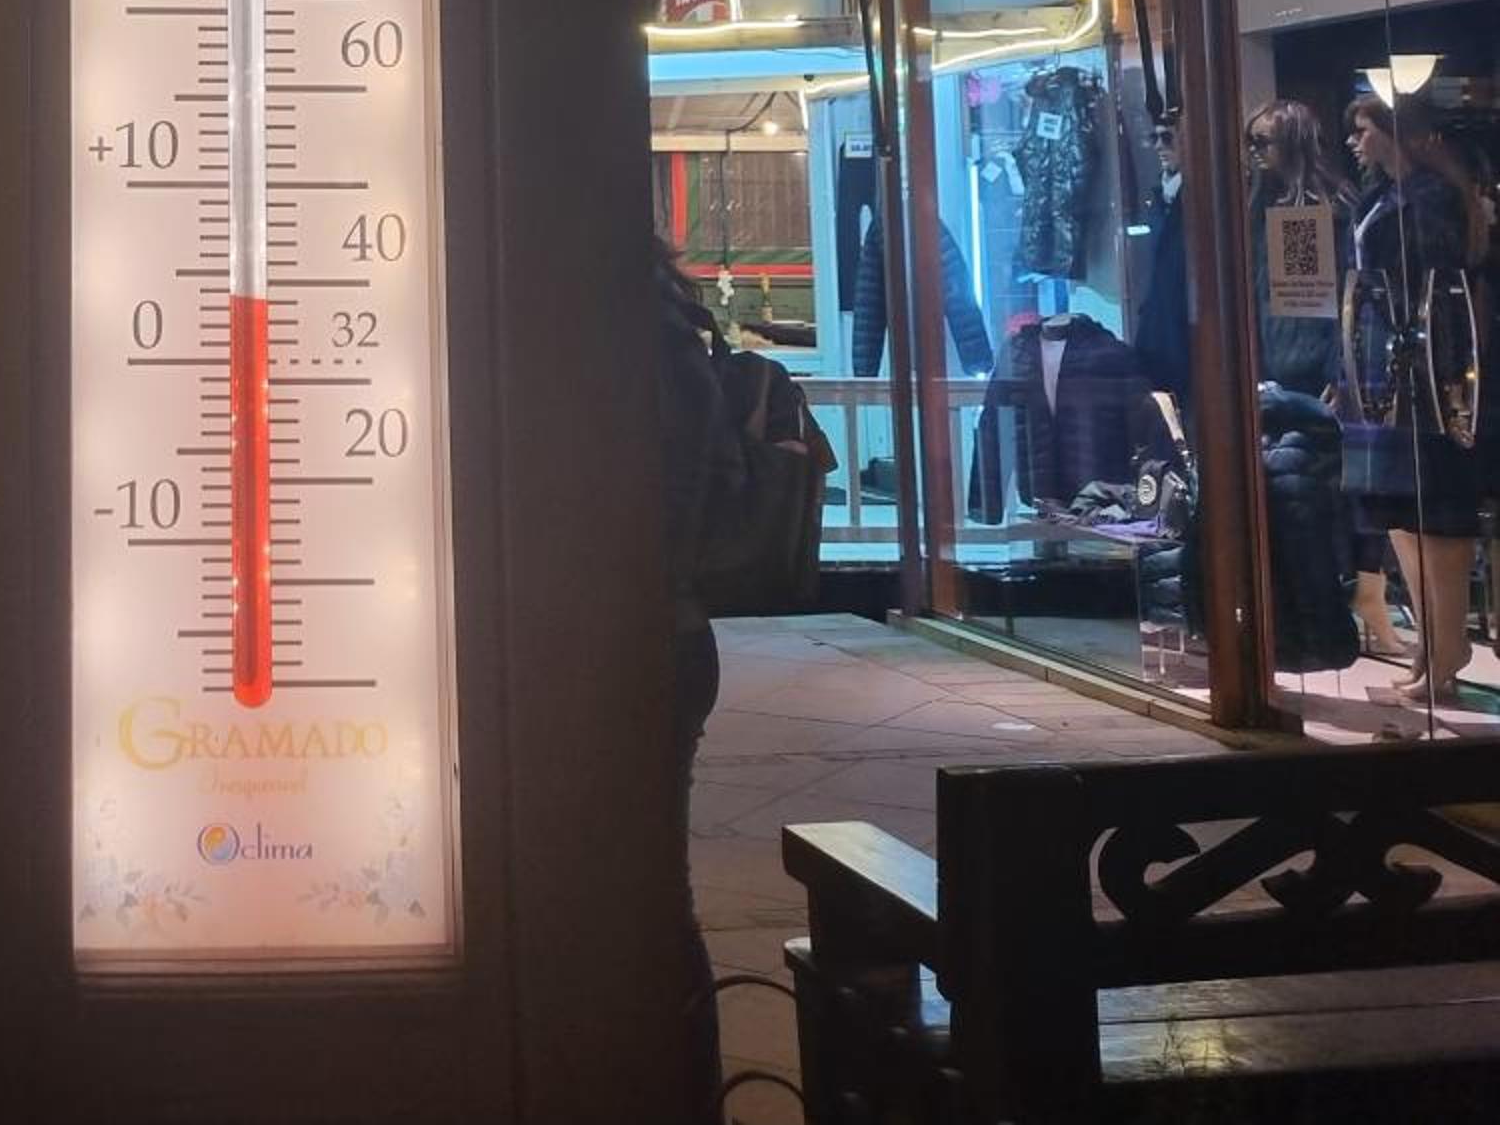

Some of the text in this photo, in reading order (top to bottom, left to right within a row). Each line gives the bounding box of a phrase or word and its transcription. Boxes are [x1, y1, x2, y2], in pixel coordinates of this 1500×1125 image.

[341, 20, 404, 68] 60
[88, 120, 179, 170] +10
[341, 213, 406, 262] 40
[132, 300, 163, 350] 0
[331, 311, 380, 348] 32
[344, 408, 408, 458] 20
[93, 478, 181, 530] -10
